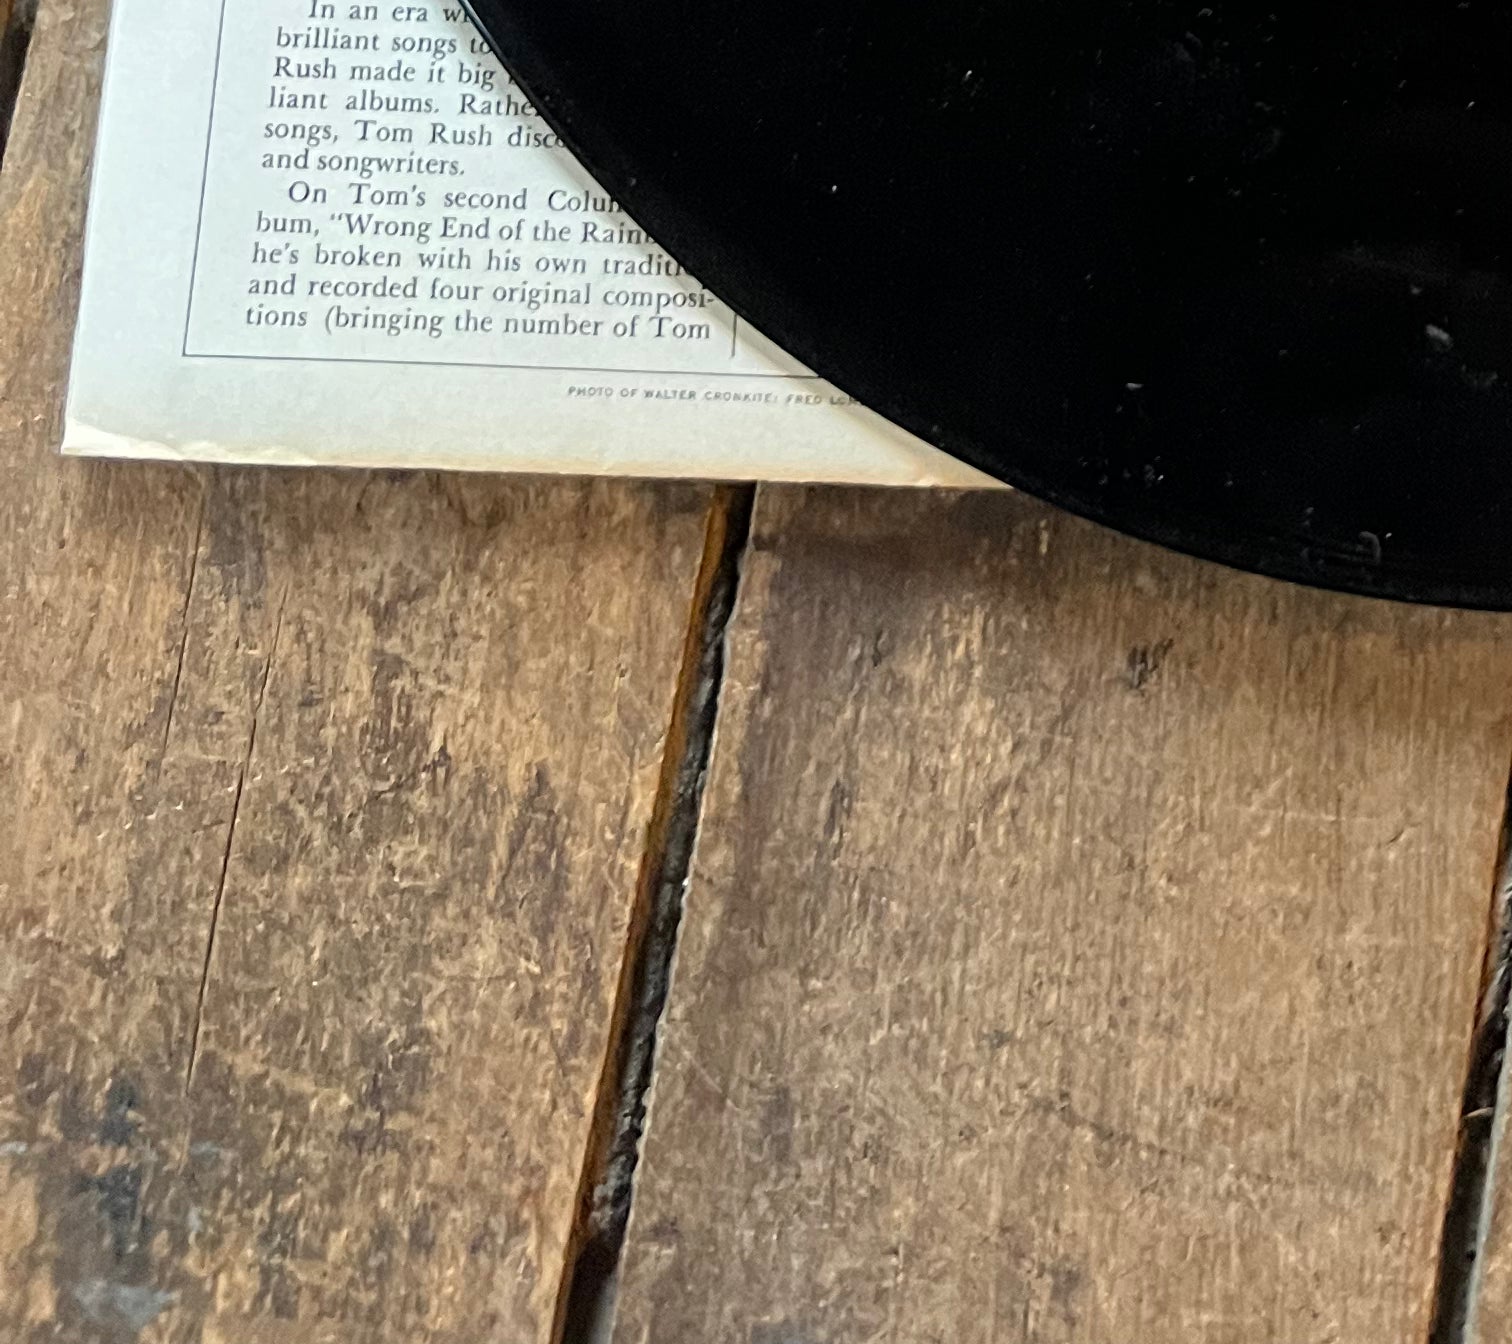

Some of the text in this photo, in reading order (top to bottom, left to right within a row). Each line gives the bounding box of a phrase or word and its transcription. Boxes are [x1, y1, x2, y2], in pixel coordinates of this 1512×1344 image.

[349, 5, 377, 20] an
[392, 7, 427, 22] era
[277, 26, 379, 51] brilliant
[392, 32, 457, 58] songs
[273, 57, 497, 92] Rush made it big
[270, 86, 327, 109] liant
[345, 89, 439, 113] albums.
[264, 123, 338, 149] songs,
[354, 120, 412, 143] Tom
[429, 123, 491, 146] Rush
[262, 149, 464, 179] and songwriters.
[289, 182, 326, 203] On
[349, 183, 425, 207] Tom's
[444, 189, 527, 210] second
[257, 211, 319, 237] bum,
[440, 217, 490, 239] End
[499, 219, 525, 240] of
[534, 220, 571, 241] the
[252, 242, 299, 264] he's
[315, 243, 401, 267] broken
[418, 247, 470, 269] with
[486, 249, 520, 272] his
[535, 257, 586, 274] own
[248, 273, 296, 295] and
[308, 276, 418, 298] recorded
[430, 277, 483, 300] four
[493, 281, 590, 309] original
[247, 303, 711, 339] tions (bringing the number of Tom
[568, 386, 613, 398] PHOTO
[621, 388, 638, 398] OF
[645, 389, 696, 400] WALTER
[786, 394, 822, 405] FRED
